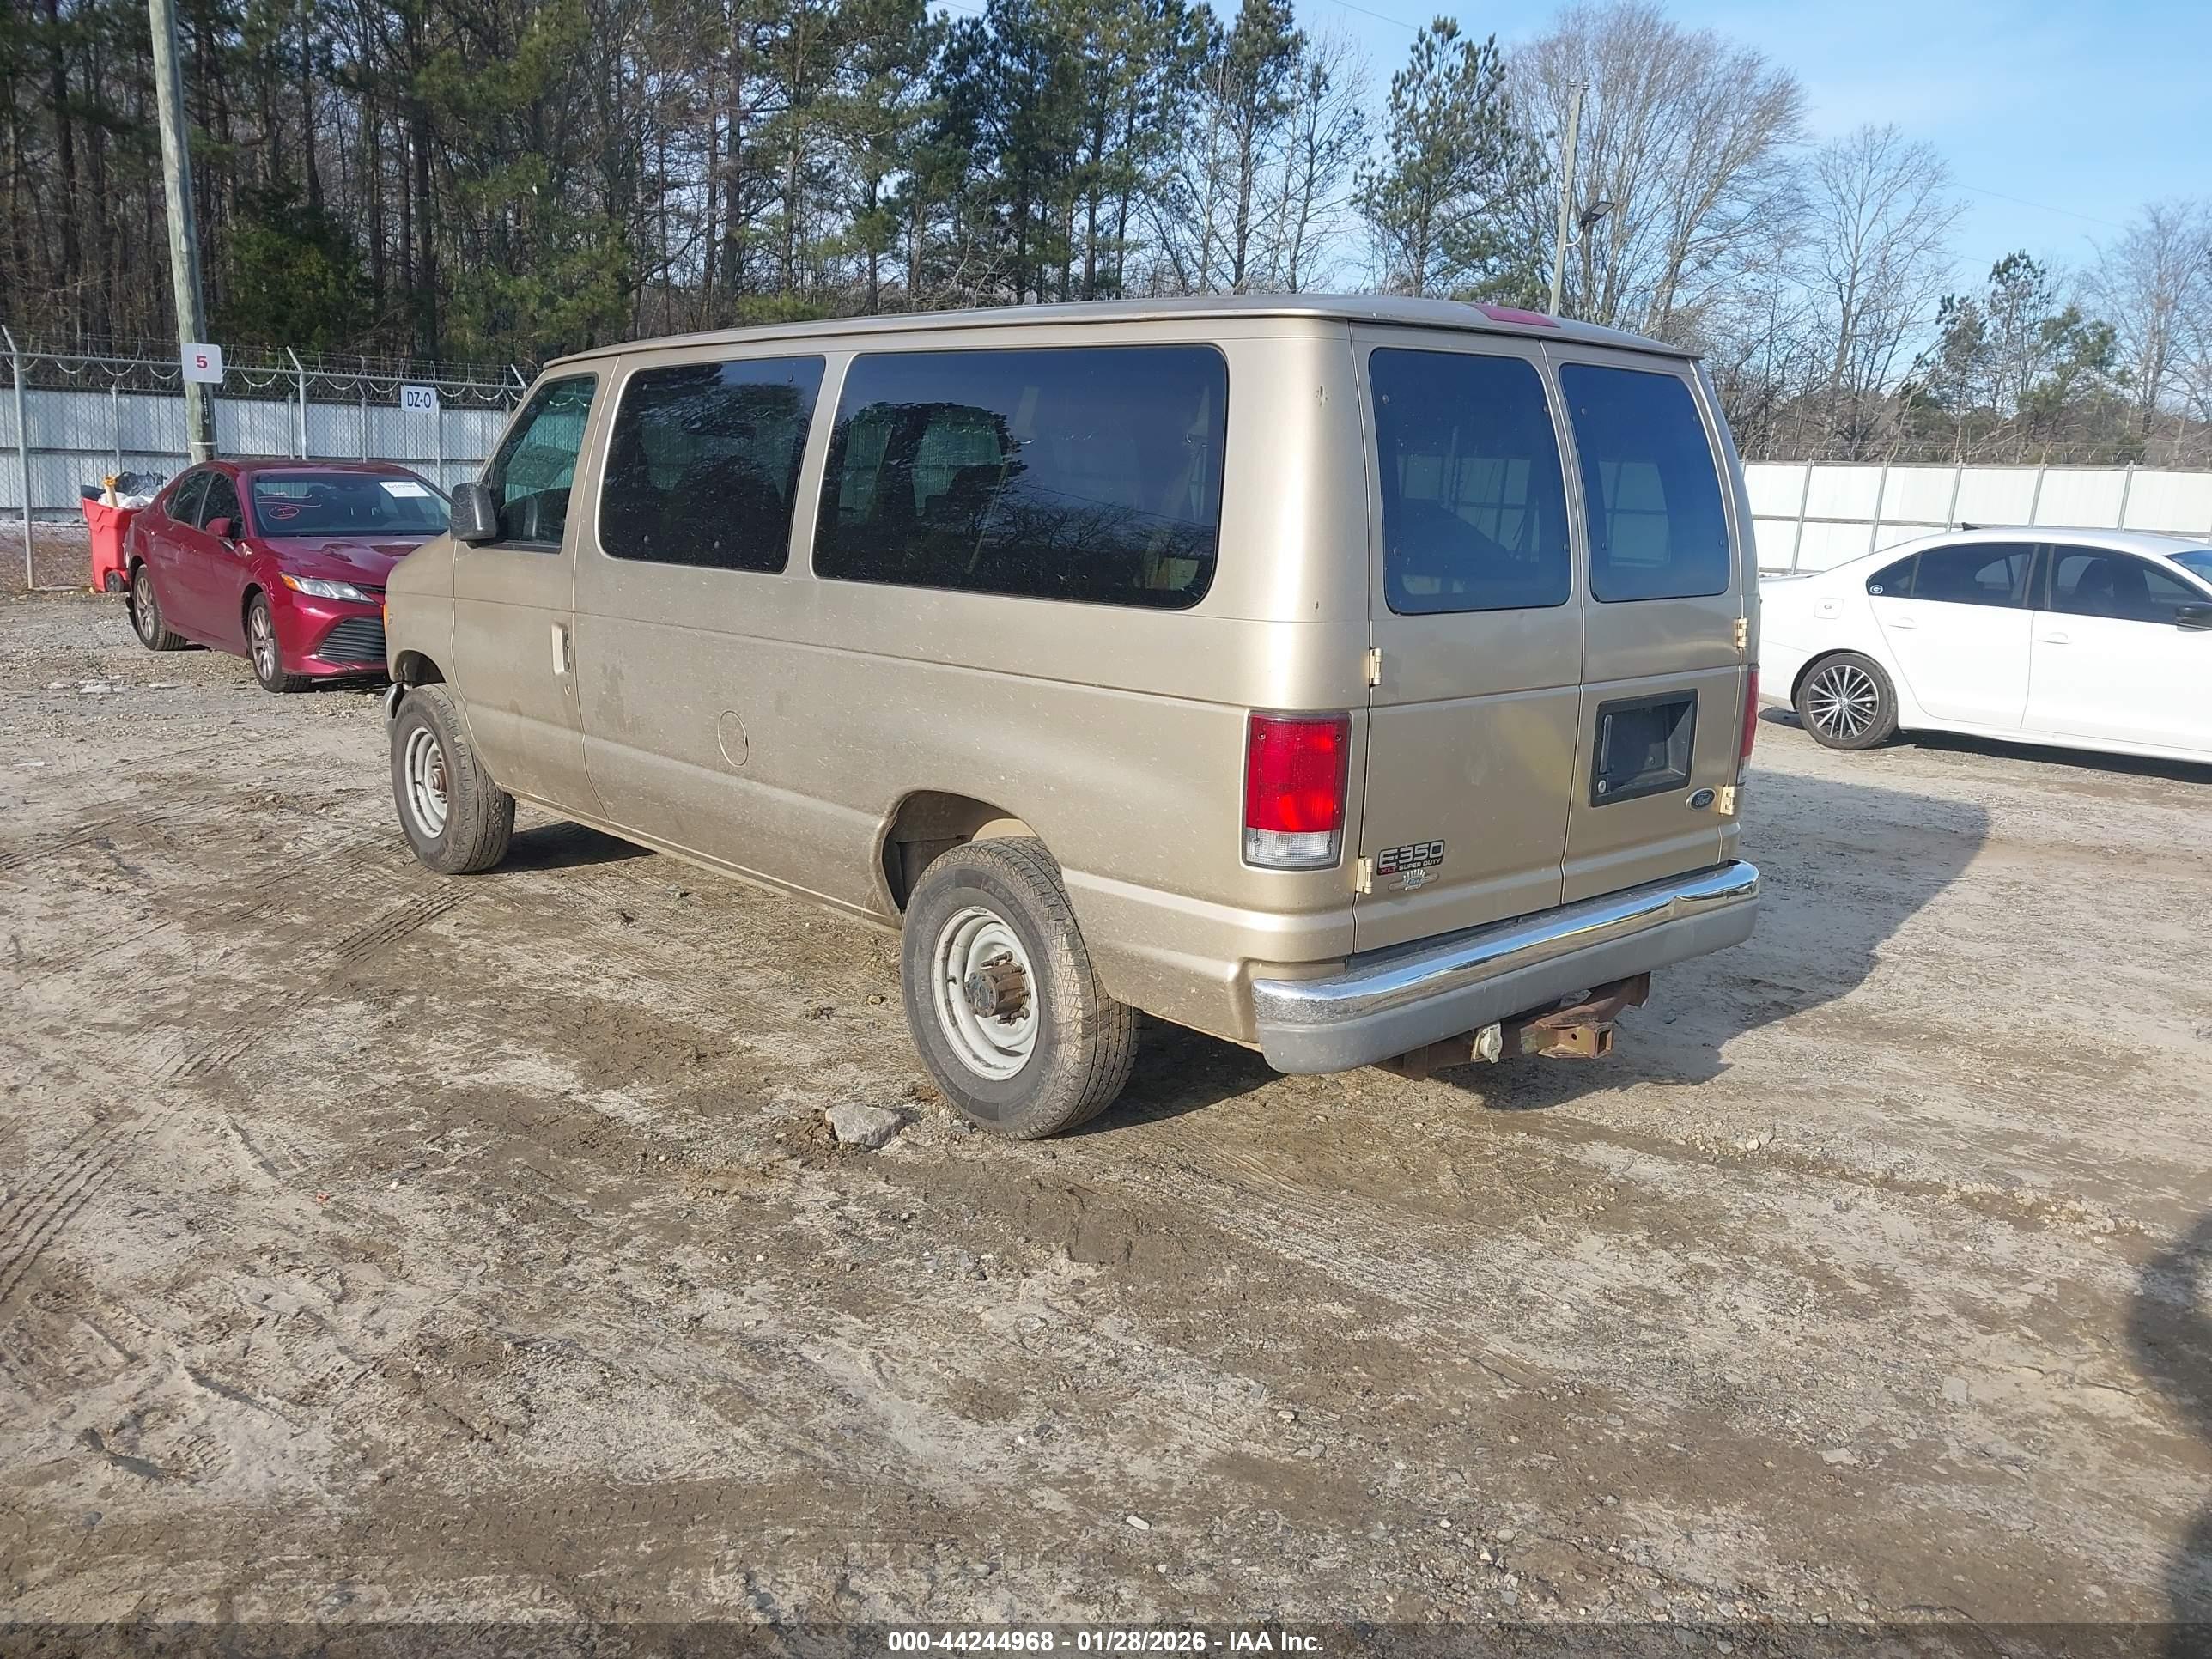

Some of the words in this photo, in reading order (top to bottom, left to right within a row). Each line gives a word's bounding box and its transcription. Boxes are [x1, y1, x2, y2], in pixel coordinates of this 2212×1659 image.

[197, 355, 208, 369] 5
[1398, 862, 1421, 871] SUPER
[1422, 858, 1441, 866] DUTY
